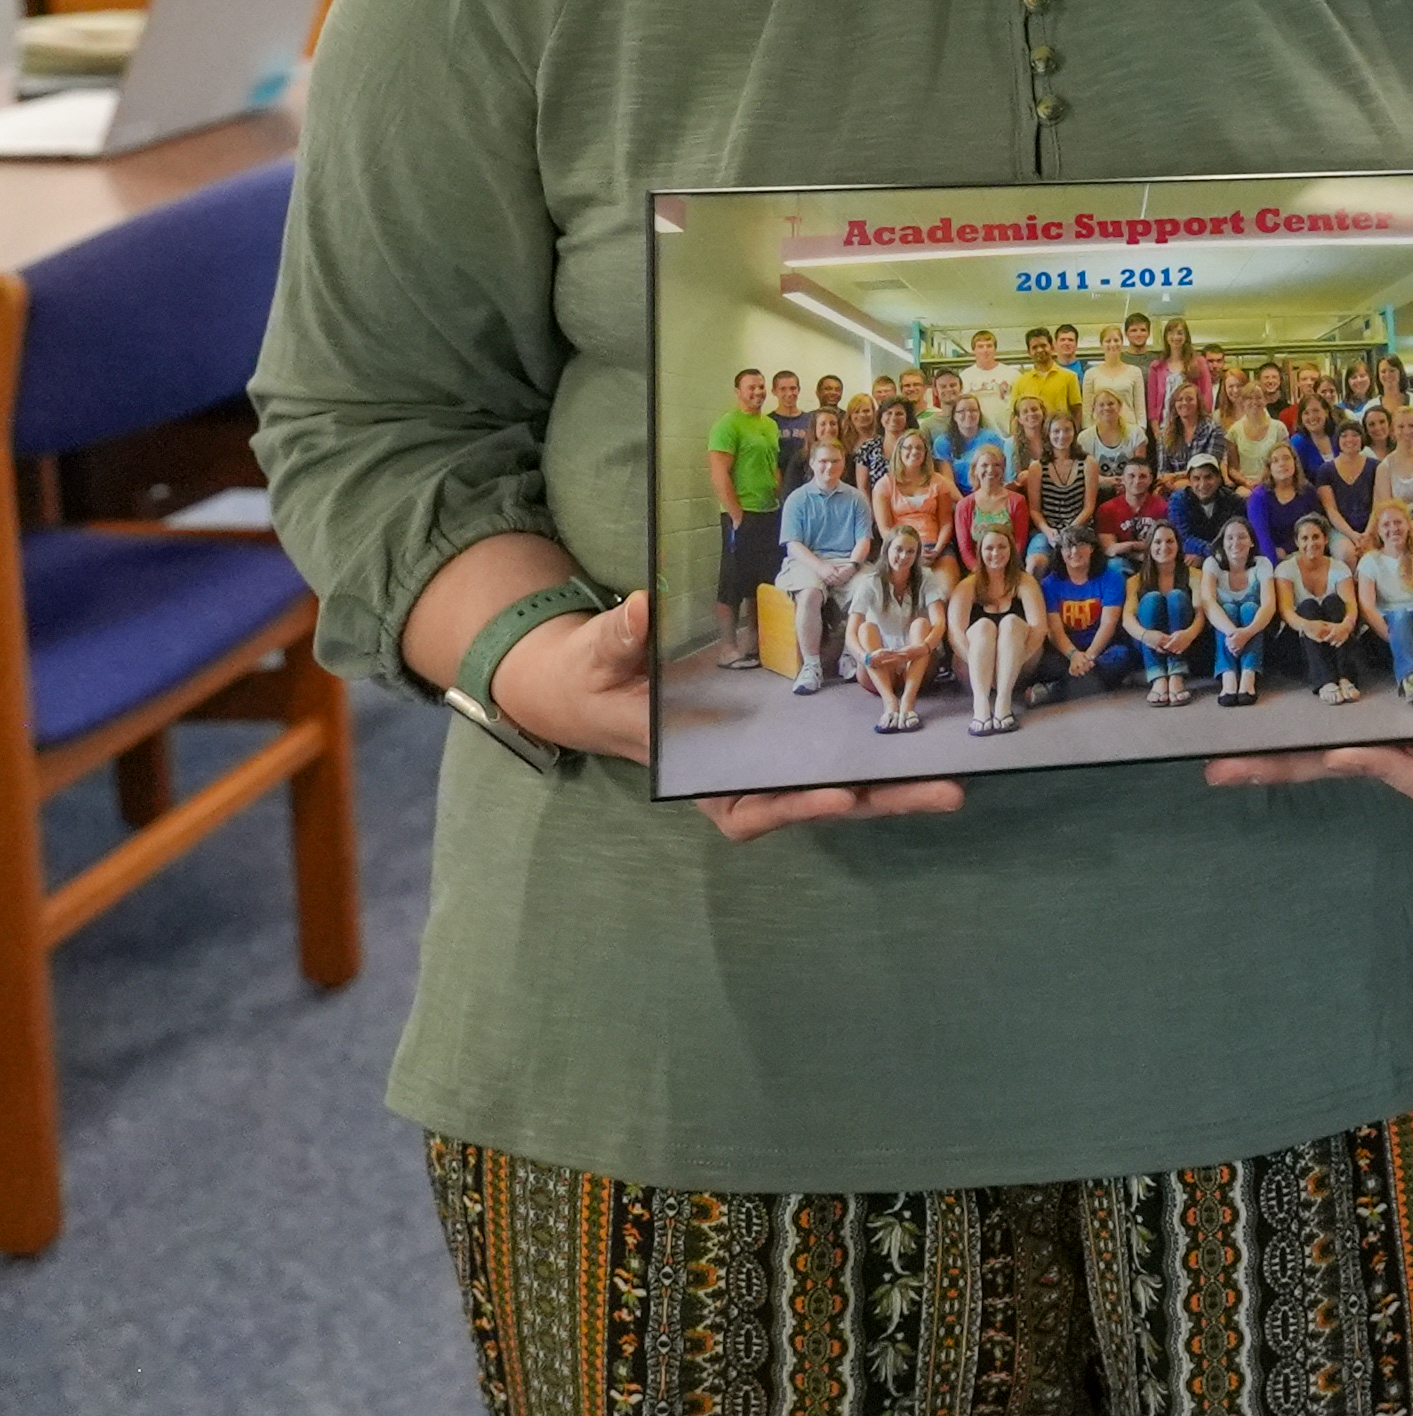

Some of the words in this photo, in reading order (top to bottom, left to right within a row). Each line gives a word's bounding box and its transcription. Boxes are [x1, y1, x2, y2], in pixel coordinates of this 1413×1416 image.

[844, 214, 1064, 246] Academic
[1074, 209, 1245, 244] Support
[1255, 207, 1394, 232] Center
[1016, 270, 1089, 291] 2011
[1120, 266, 1193, 288] 2012
